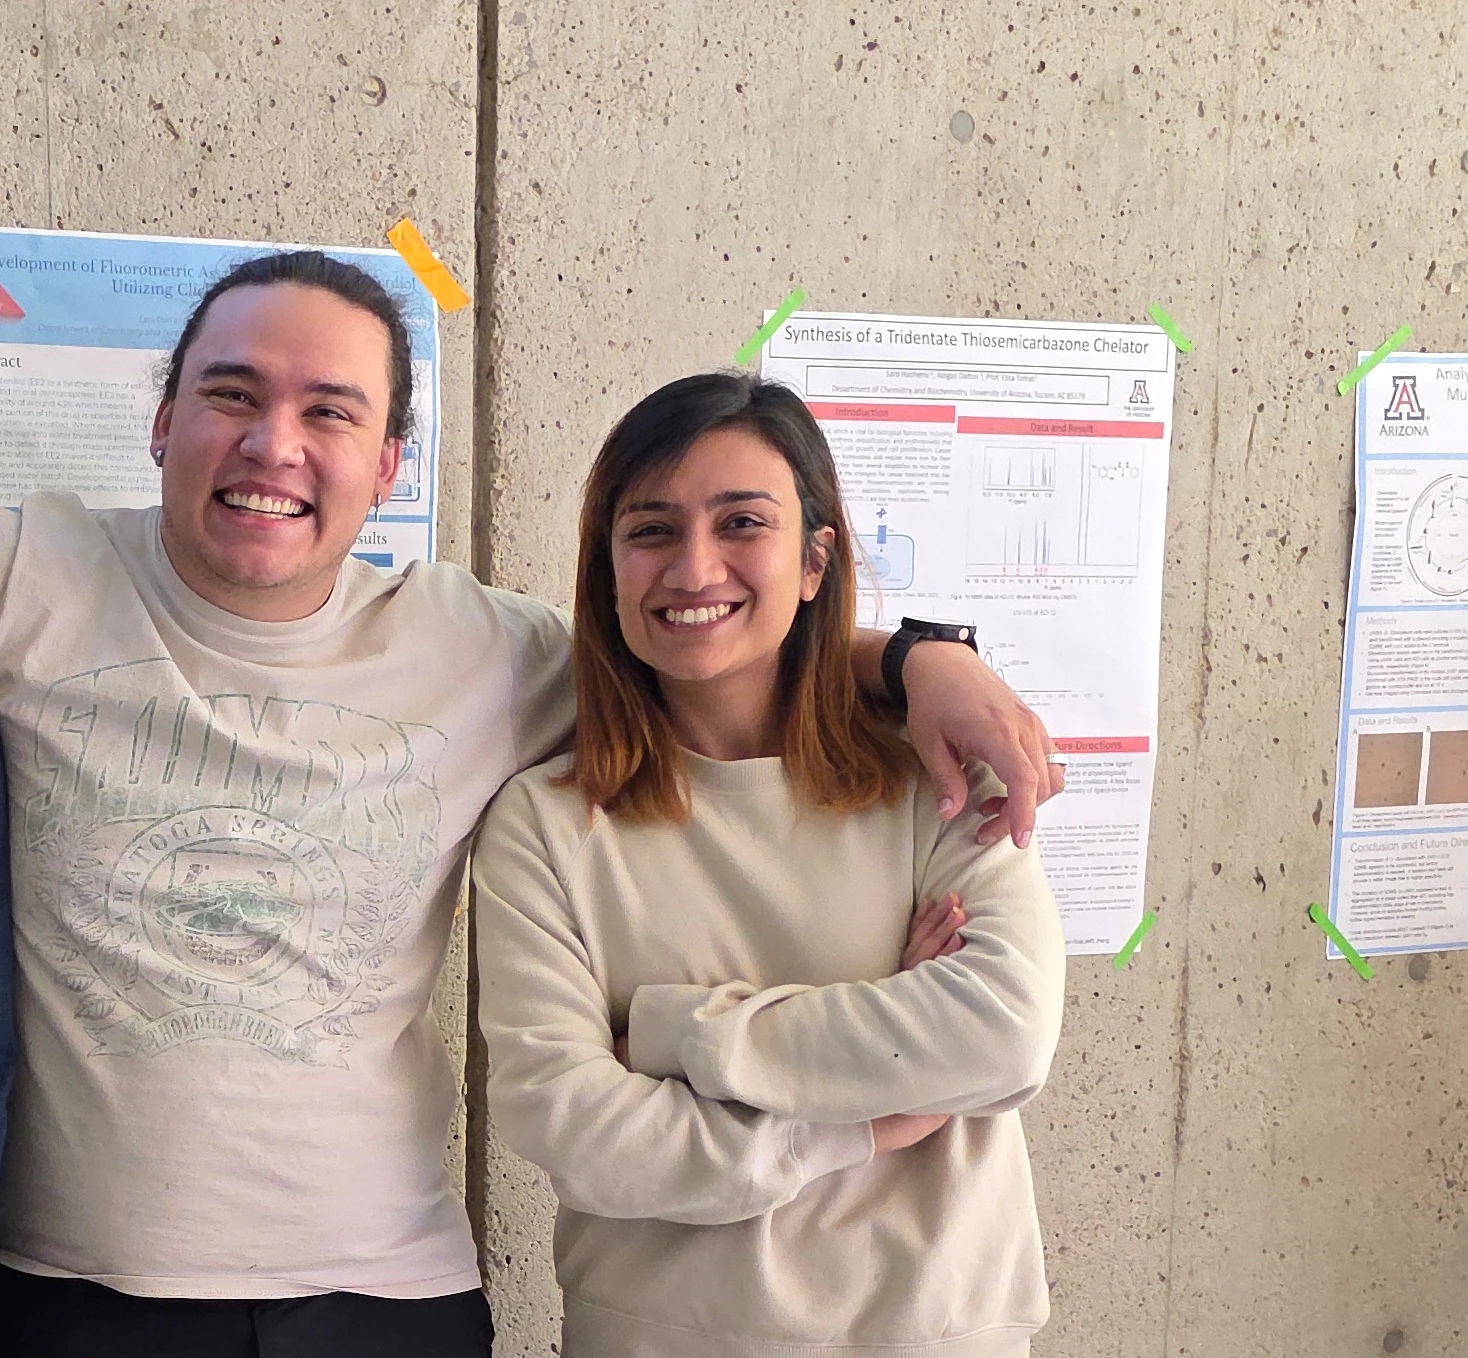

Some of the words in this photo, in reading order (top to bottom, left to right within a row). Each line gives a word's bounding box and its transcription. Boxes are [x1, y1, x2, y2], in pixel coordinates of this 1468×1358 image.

[81, 259, 94, 272] of
[101, 260, 191, 276] Fluorometric
[112, 279, 173, 298] Utilizing
[784, 325, 852, 343] Synthesis
[856, 327, 870, 342] of
[874, 332, 882, 343] a
[887, 329, 957, 345] Tridentate
[961, 332, 1089, 351] Thiosemicarbazone
[1094, 338, 1149, 353] Chelator
[1384, 376, 1425, 420] A
[835, 408, 888, 420] Introduction
[1030, 422, 1049, 435] Data
[1051, 423, 1066, 435] and
[1068, 424, 1093, 436] Result
[1379, 424, 1428, 436] ARIZONA
[358, 532, 387, 544] sults
[1075, 741, 1122, 751] Directions
[1350, 842, 1399, 852] Conclusion
[1401, 840, 1417, 850] and
[1420, 839, 1451, 848] Future
